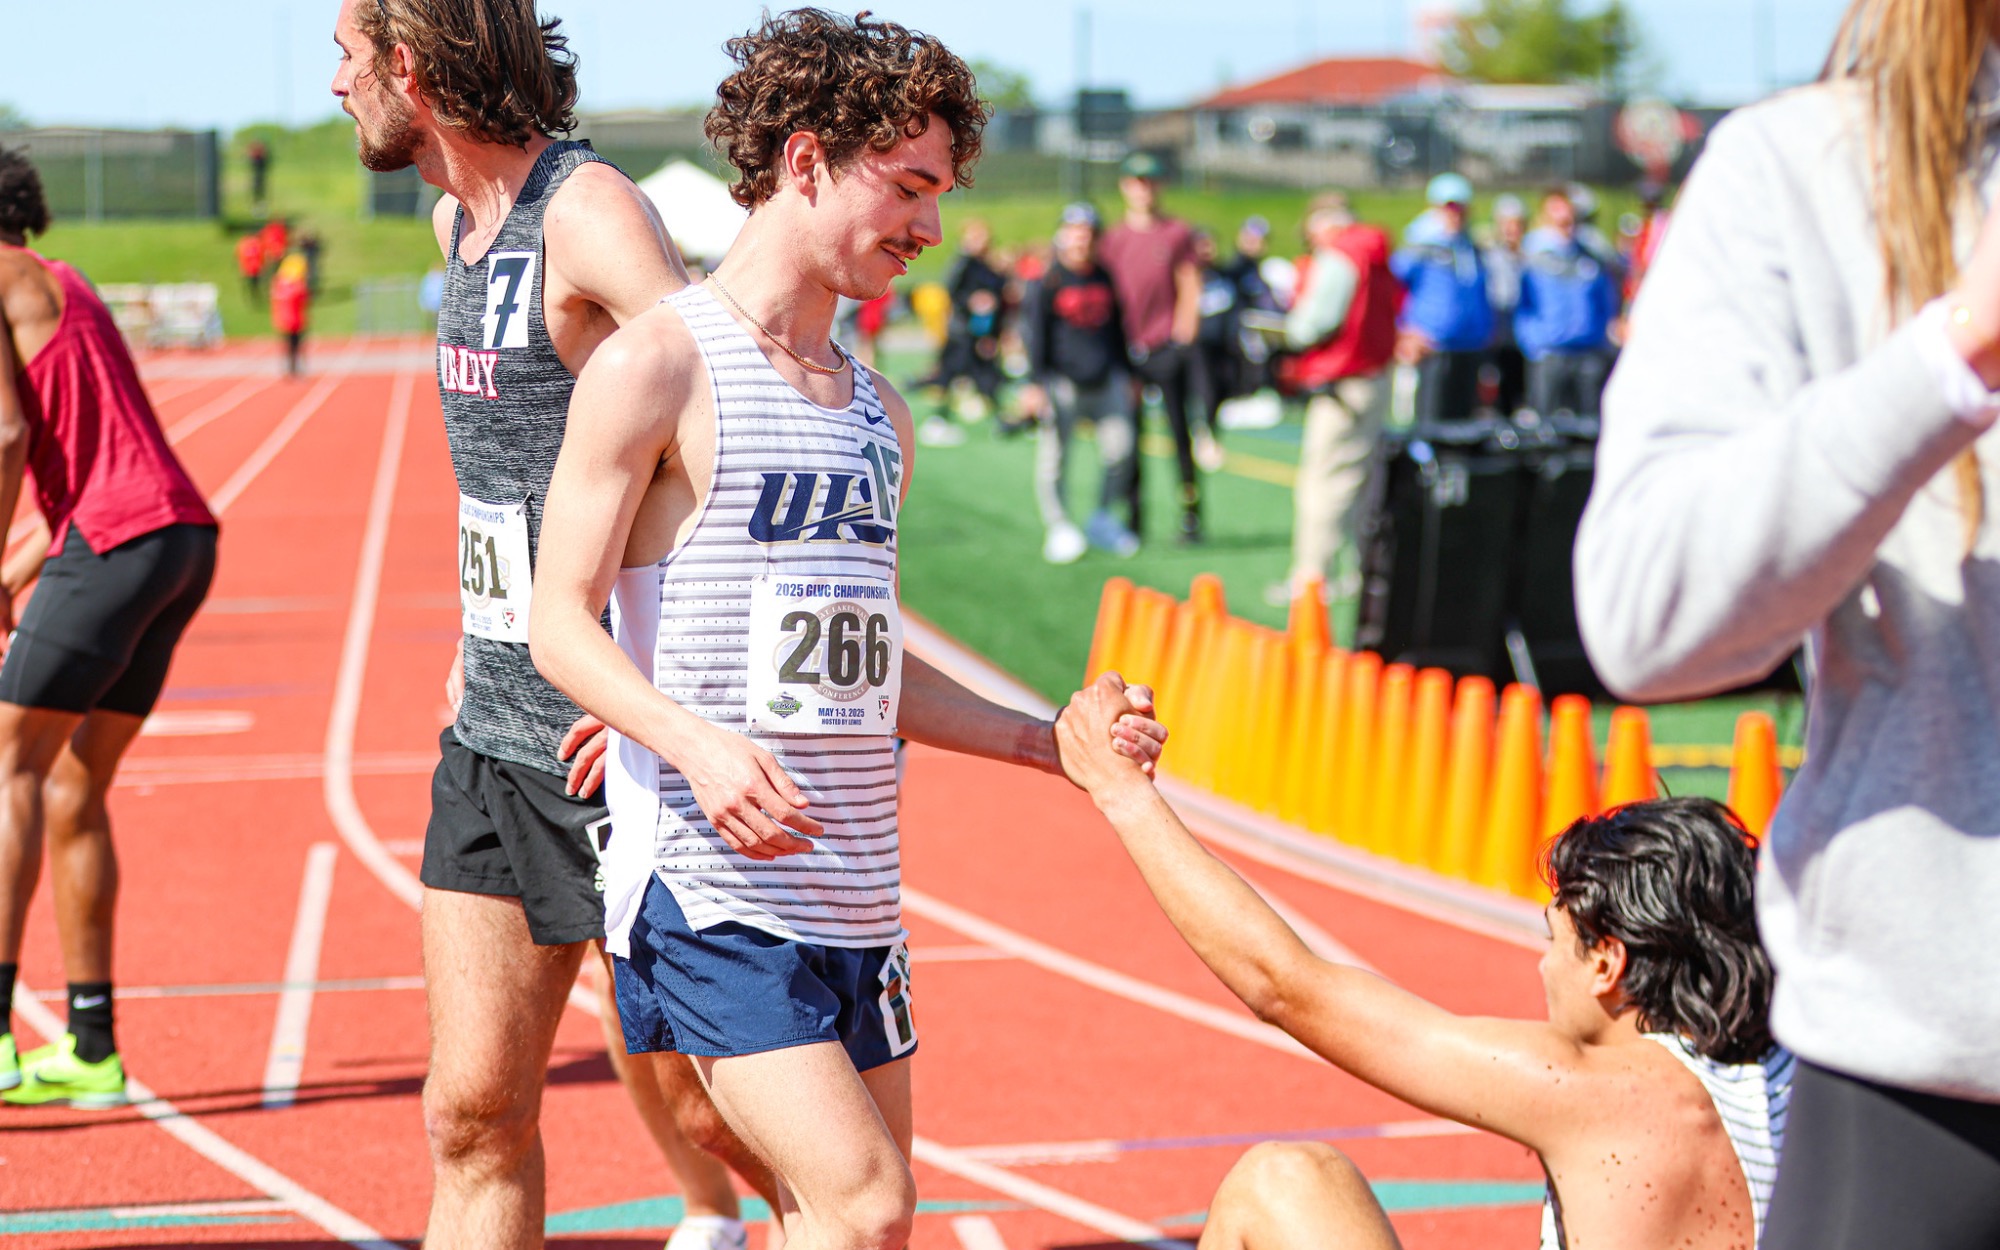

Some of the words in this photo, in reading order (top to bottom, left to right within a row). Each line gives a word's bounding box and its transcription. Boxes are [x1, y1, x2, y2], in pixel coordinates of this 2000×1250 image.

[489, 257, 531, 348] 7
[461, 525, 508, 600] 251
[775, 583, 804, 597] 2025
[806, 584, 832, 598] GLVC
[833, 584, 890, 600] CHAMPIONSHIPS
[778, 610, 889, 687] 266
[817, 684, 865, 700] CONFERENCE
[818, 707, 833, 717] MAY
[848, 708, 865, 718] 2025
[821, 718, 841, 726] HOSTED
